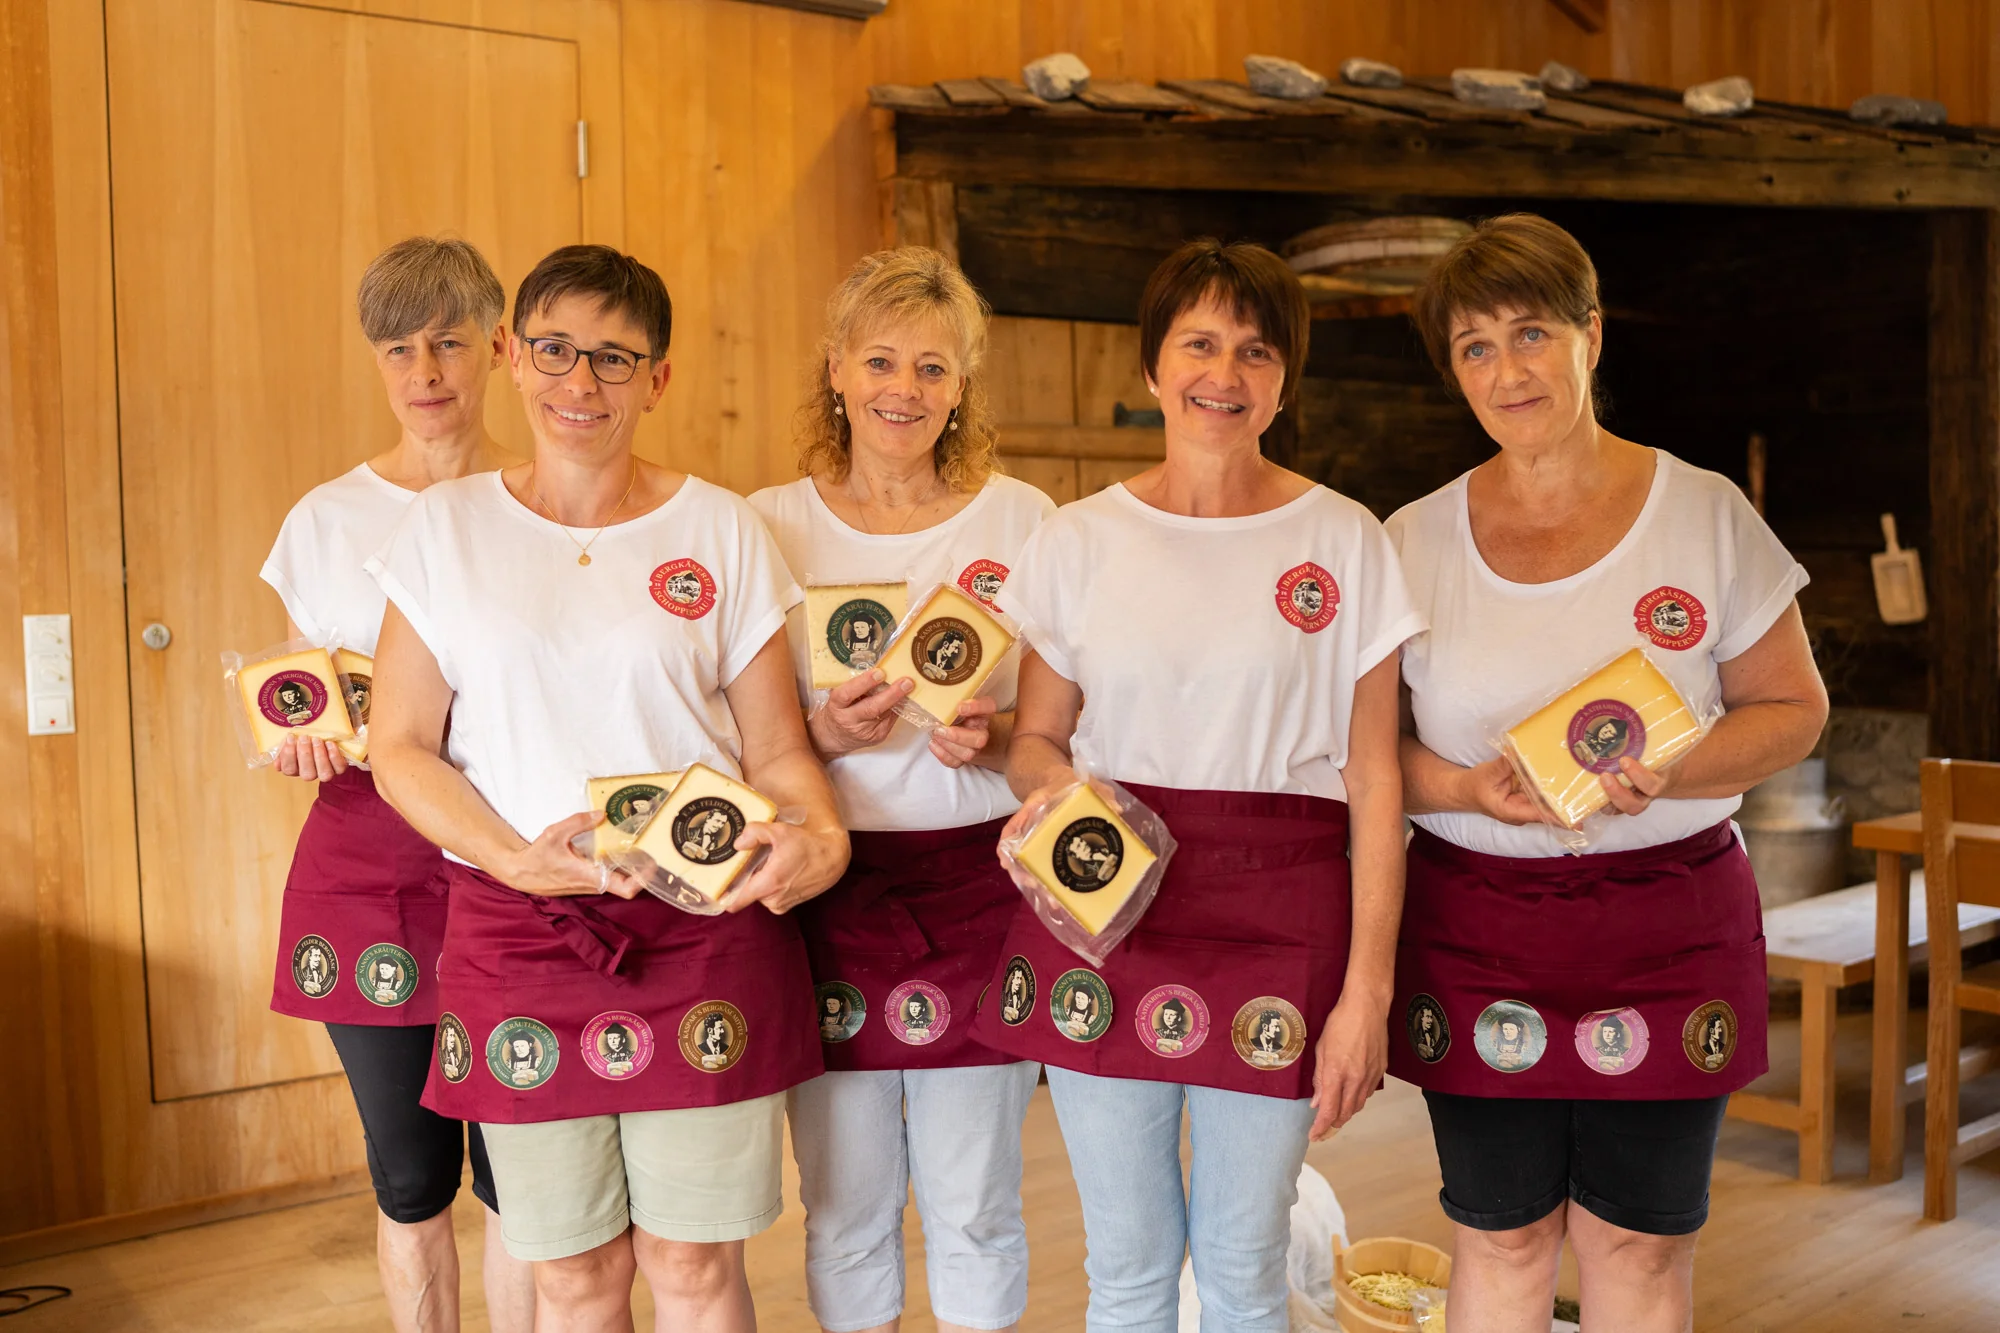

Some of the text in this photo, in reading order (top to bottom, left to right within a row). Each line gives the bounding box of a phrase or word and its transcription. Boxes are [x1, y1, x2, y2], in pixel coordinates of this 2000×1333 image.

[656, 560, 712, 587] BERGKÄSEREI
[963, 562, 1008, 580] BERGKÄSER
[1282, 565, 1335, 596] BERGKÄSEREI
[1639, 588, 1700, 612] BERGKÄSEREI
[1641, 626, 1702, 648] SCHOPPERNAU
